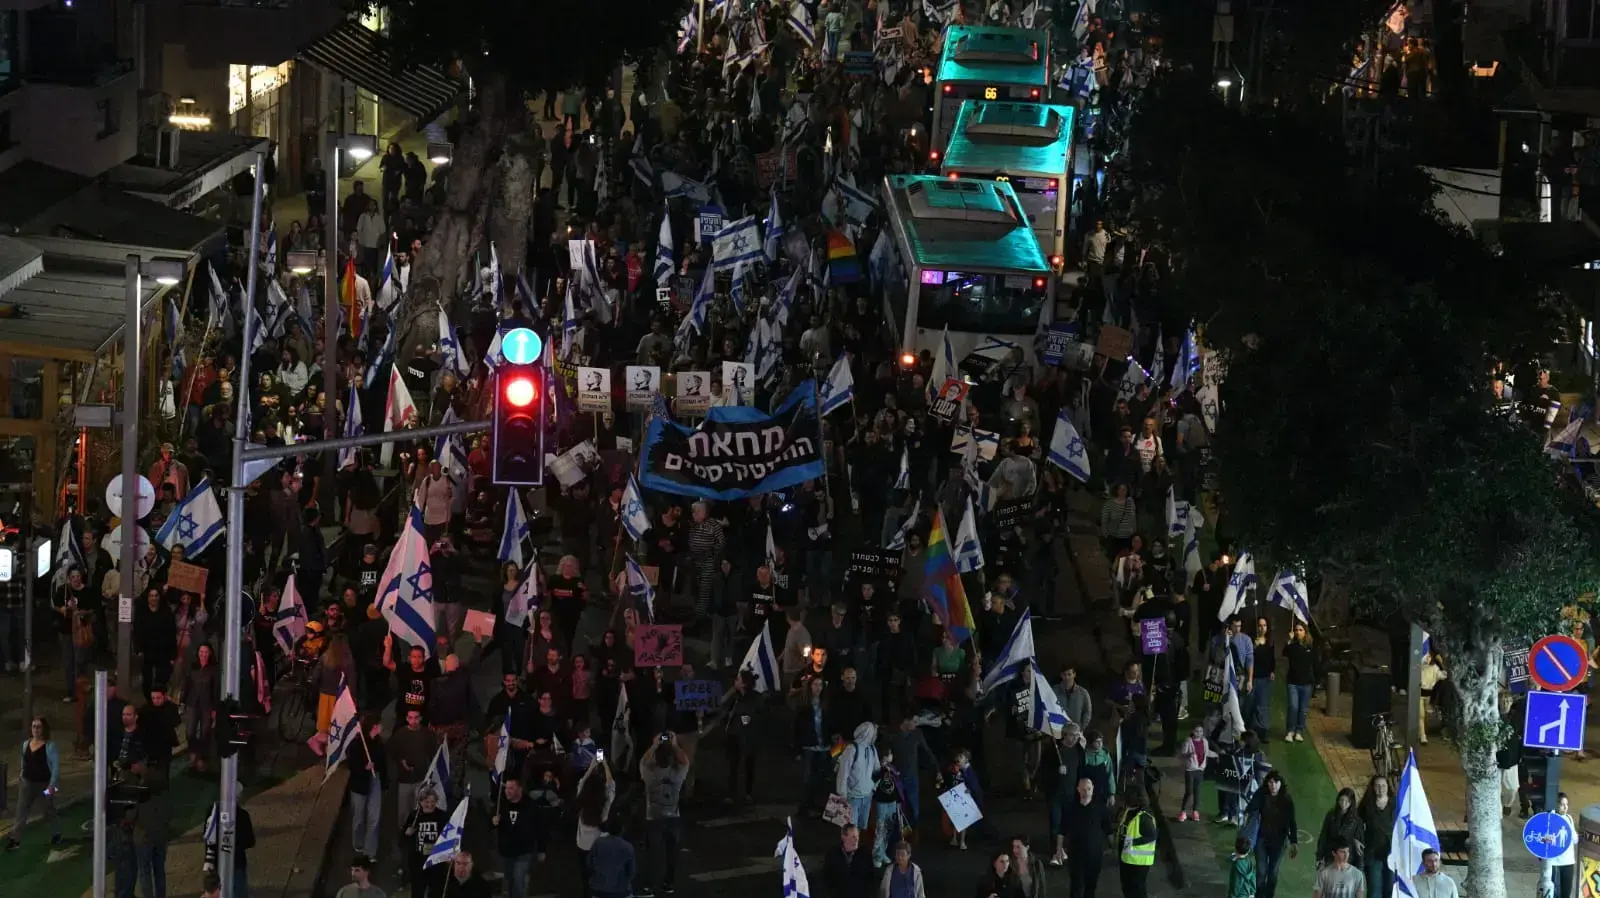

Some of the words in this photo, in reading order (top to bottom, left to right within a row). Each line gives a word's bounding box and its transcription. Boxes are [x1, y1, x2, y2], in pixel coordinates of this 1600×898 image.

[985, 87, 998, 100] 66
[688, 426, 785, 459] מחאת
[664, 436, 816, 483] ההייטקיסטים
[852, 552, 880, 562] לבטחון
[884, 556, 900, 565] השר
[682, 683, 713, 695] FREE
[679, 695, 719, 708] ISRAEL
